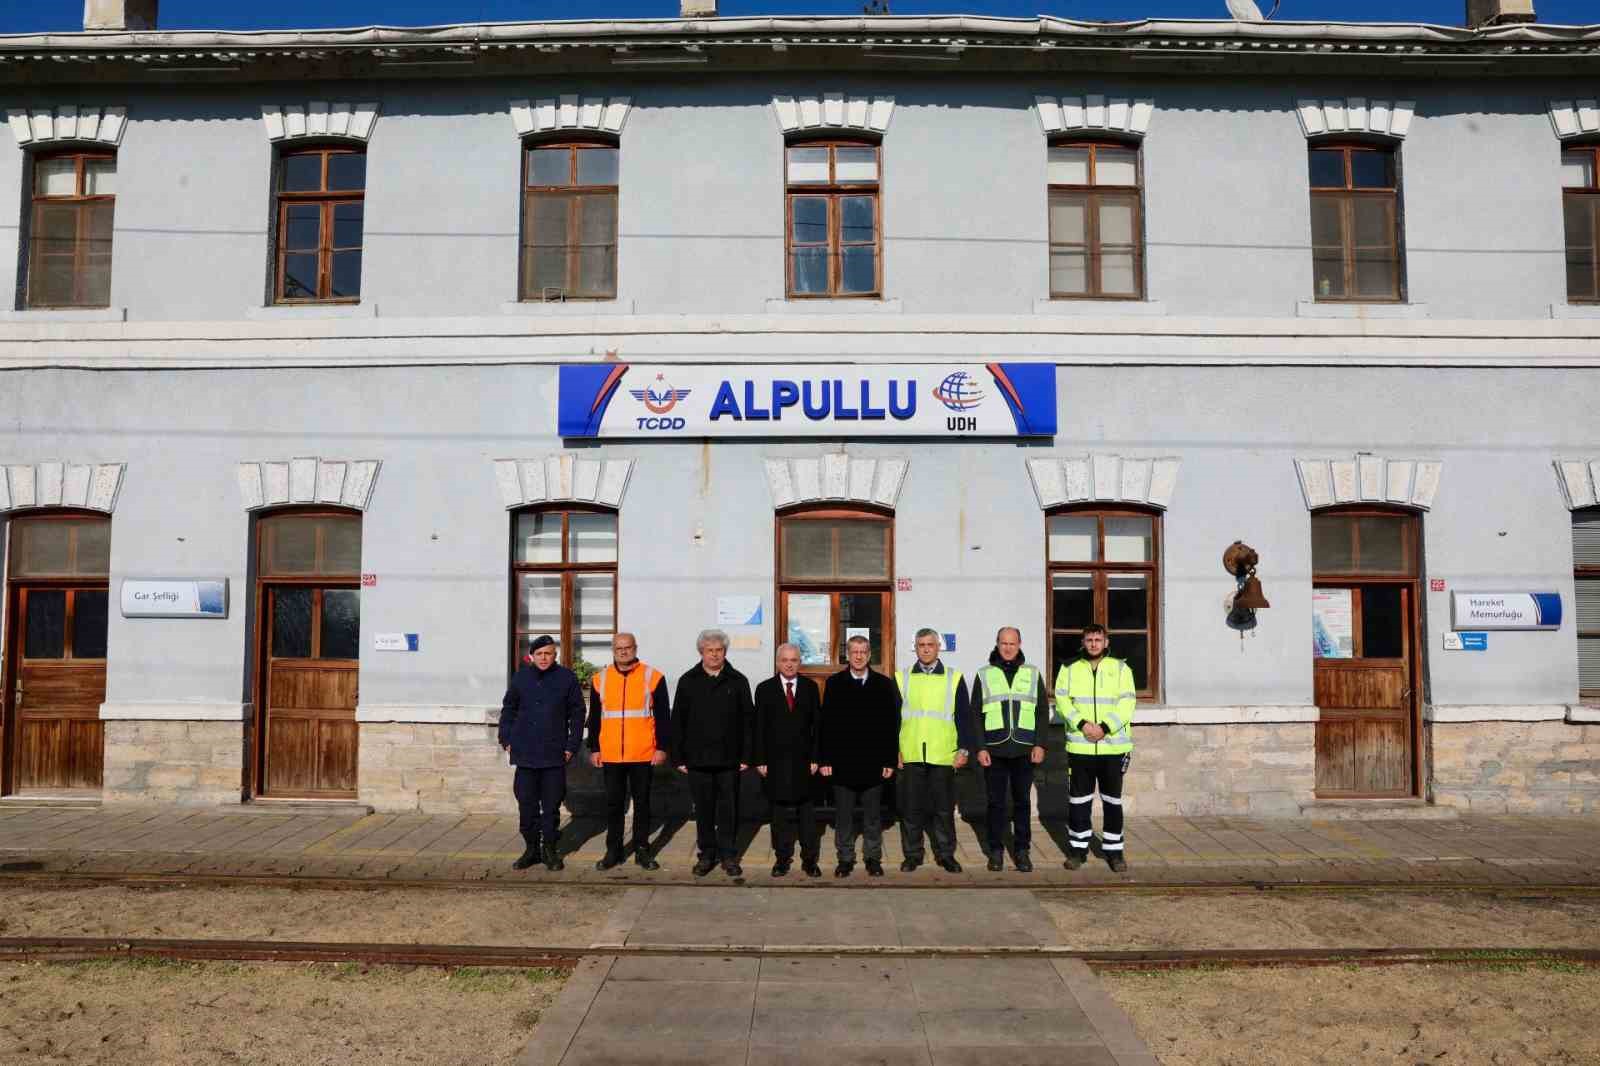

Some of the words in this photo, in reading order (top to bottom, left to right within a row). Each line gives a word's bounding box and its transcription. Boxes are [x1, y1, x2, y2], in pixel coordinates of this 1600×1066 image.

[709, 379, 917, 421] ALPULLU
[636, 417, 686, 430] TCDD
[946, 416, 977, 431] UDH
[134, 591, 149, 600] Gar
[1470, 599, 1505, 607] Hareket
